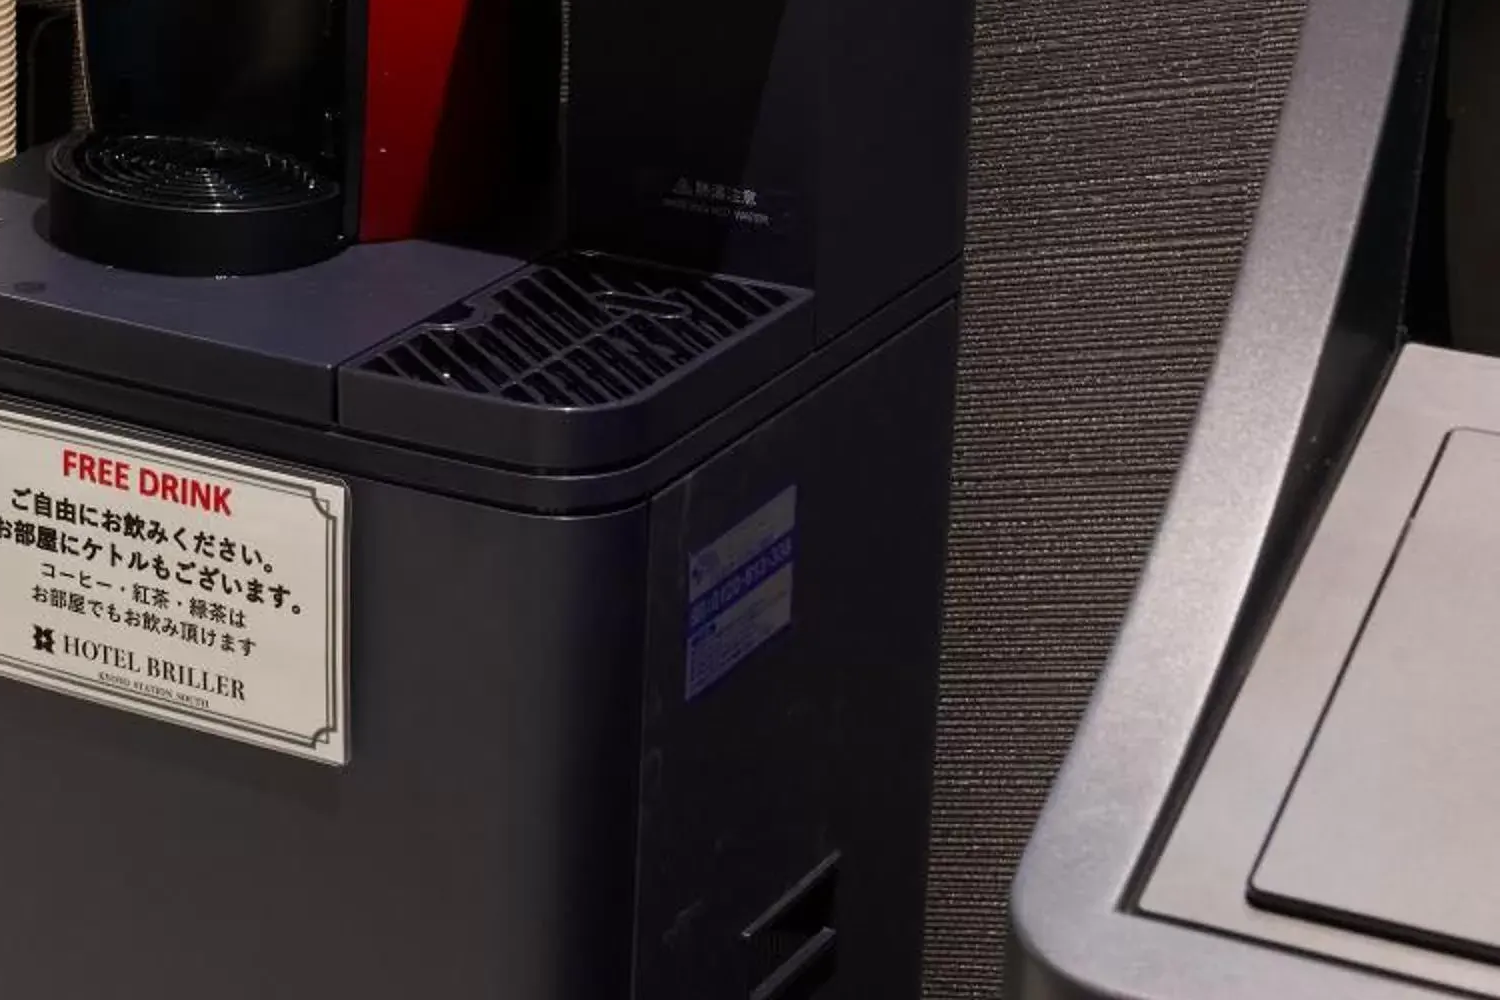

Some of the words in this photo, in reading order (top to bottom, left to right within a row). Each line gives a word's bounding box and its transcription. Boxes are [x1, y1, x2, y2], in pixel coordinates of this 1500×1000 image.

[63, 449, 131, 490] FREE
[139, 468, 231, 515] DRINK
[11, 487, 276, 574] ご自由にお飲みください。
[32, 585, 256, 657] お部屋でもお飲み頂けます
[41, 562, 246, 628] コーヒー・紅茶・緑茶は
[63, 634, 141, 673] HOTEL
[146, 657, 246, 701] BRILLER
